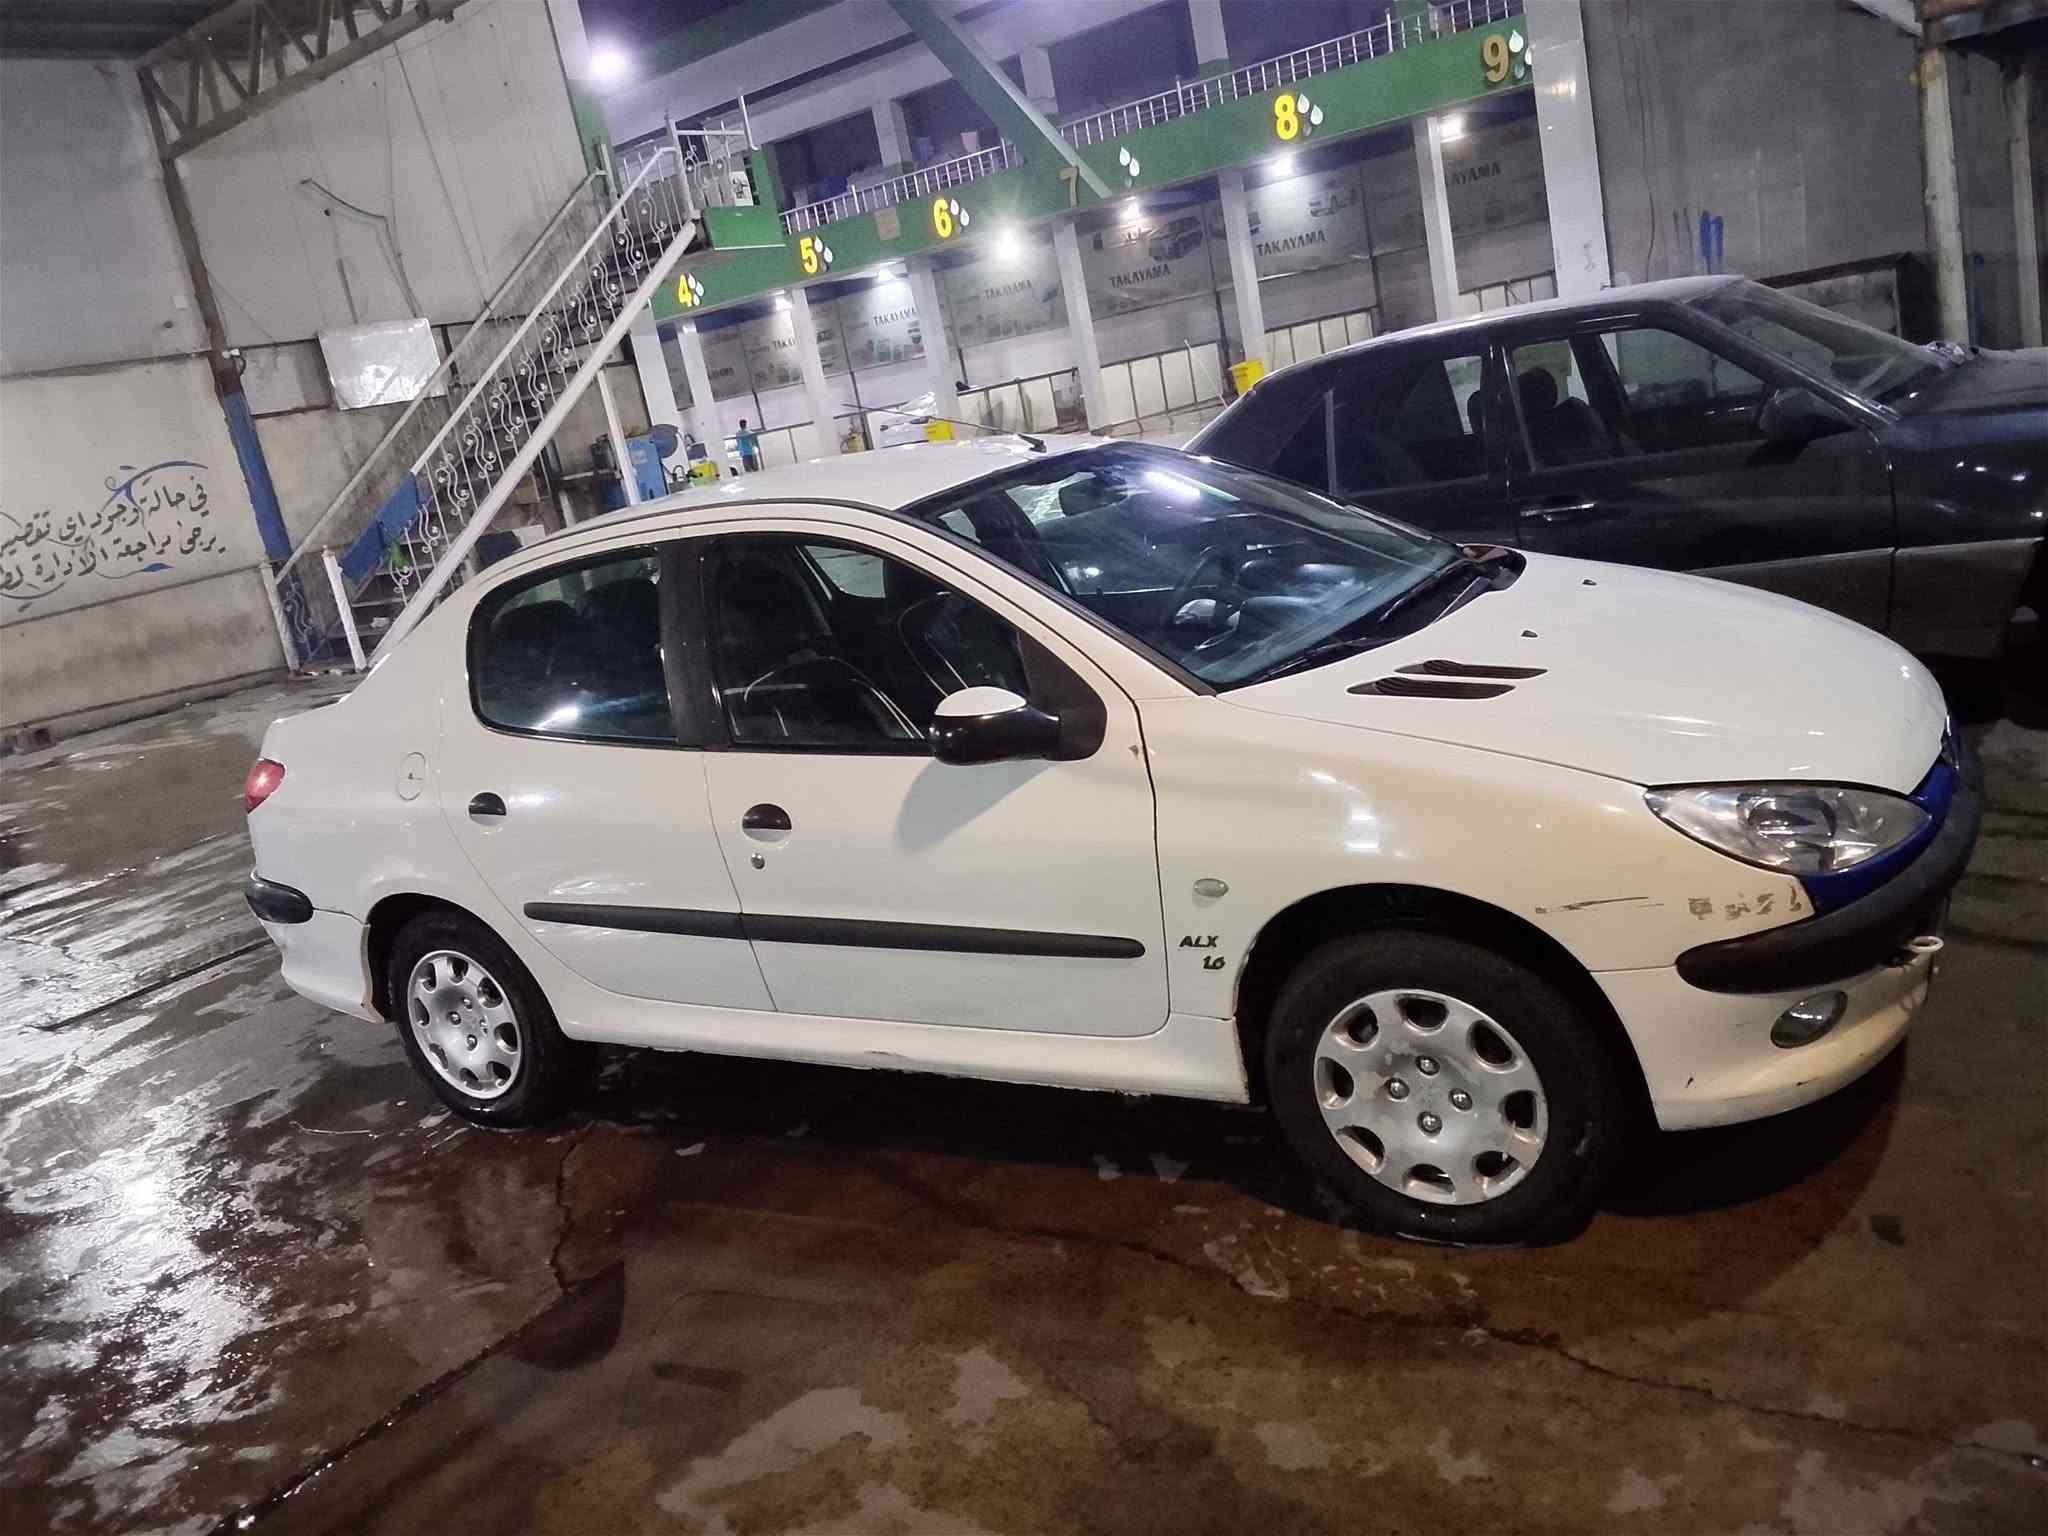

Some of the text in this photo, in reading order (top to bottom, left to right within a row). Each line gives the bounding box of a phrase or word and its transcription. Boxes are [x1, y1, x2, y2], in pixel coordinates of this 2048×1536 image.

[1483, 34, 1511, 83] 9
[1274, 94, 1299, 141] 8
[1059, 166, 1079, 207] 7
[933, 197, 953, 239] 6
[800, 237, 818, 274] 5
[1256, 229, 1326, 257] TAKAYAMA
[678, 274, 693, 307] 4
[983, 279, 1033, 301] TAKAYAMA
[1109, 263, 1171, 289] TAKAYAMA
[139, 485, 186, 517] حالة
[189, 474, 210, 518] في
[91, 503, 140, 535] وجود
[1179, 935, 1219, 948] ALX
